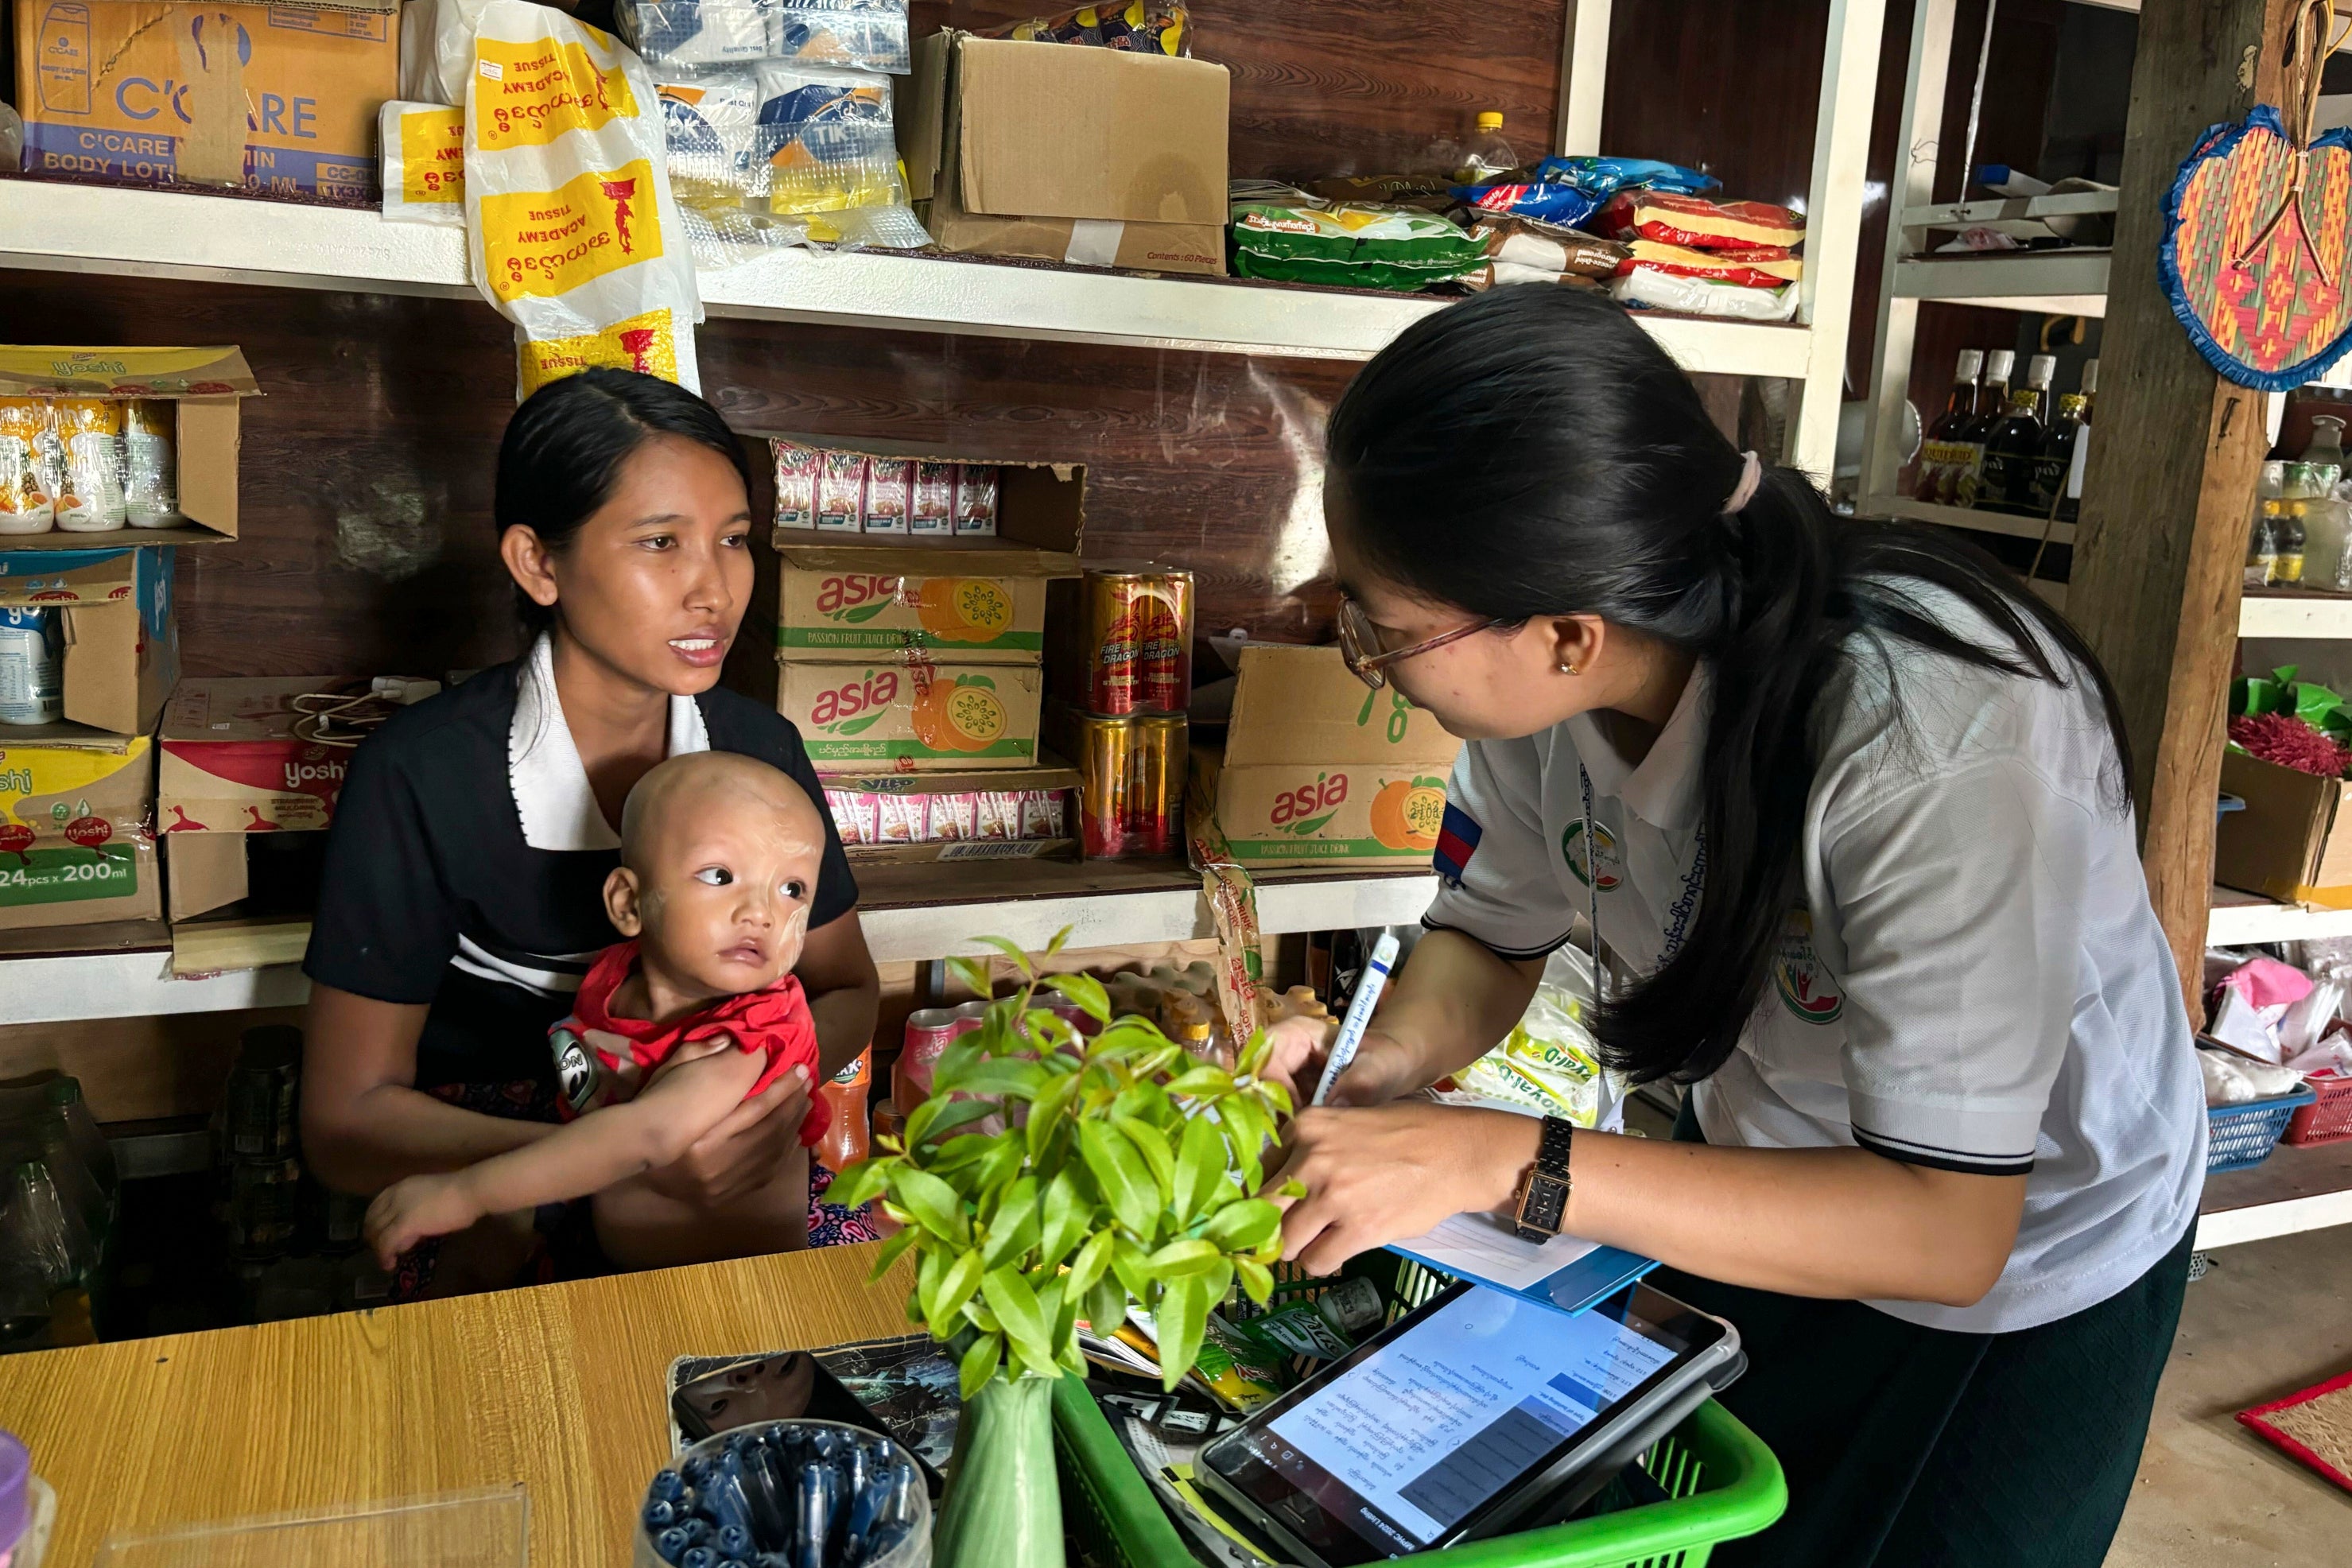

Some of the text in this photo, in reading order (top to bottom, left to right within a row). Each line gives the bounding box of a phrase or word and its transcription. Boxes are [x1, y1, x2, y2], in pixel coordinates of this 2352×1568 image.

[514, 52, 556, 72] TISSUE
[80, 132, 169, 157] C'CARE
[45, 153, 111, 173] BODY
[122, 160, 175, 183] LOTI
[528, 204, 572, 221] TISSUE
[518, 213, 586, 243] ACADEMY
[1147, 251, 1180, 261] Contents
[1194, 254, 1217, 265] Pieces
[807, 631, 906, 646] PASSION FRUIT JUICE DRIN
[1100, 643, 1122, 655] FIRE
[1103, 648, 1139, 664] DRAGON
[1143, 646, 1180, 661] DRAGON
[811, 669, 898, 724] asia
[1270, 771, 1349, 825] asia
[1499, 1064, 1569, 1116] Royal-D
[1360, 1506, 1380, 1523] Listing
[1376, 1519, 1395, 1536] 2024
